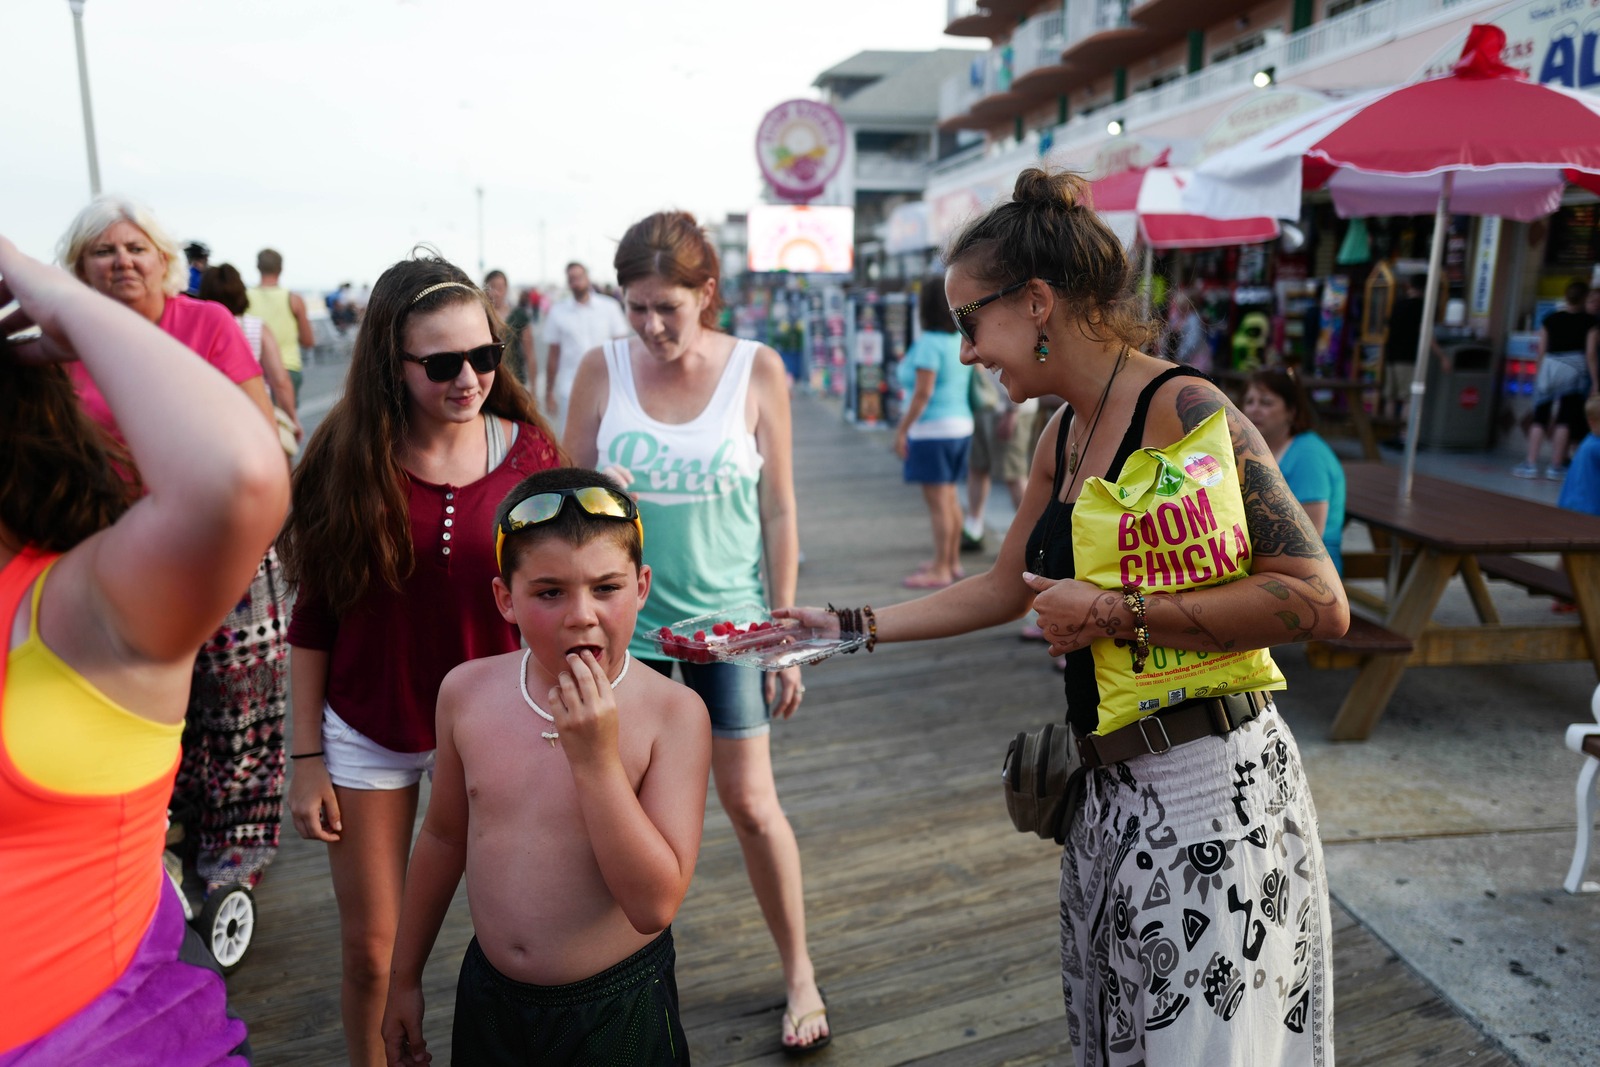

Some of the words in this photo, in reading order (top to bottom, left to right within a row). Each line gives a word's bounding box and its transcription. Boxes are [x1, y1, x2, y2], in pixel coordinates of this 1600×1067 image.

[608, 431, 739, 492] Pink
[1119, 487, 1218, 552] BOOM
[1119, 523, 1250, 588] CHICKA
[1135, 671, 1163, 680] contains
[1165, 665, 1190, 677] nothing
[1191, 662, 1202, 670] but
[1202, 652, 1239, 667] ingredients
